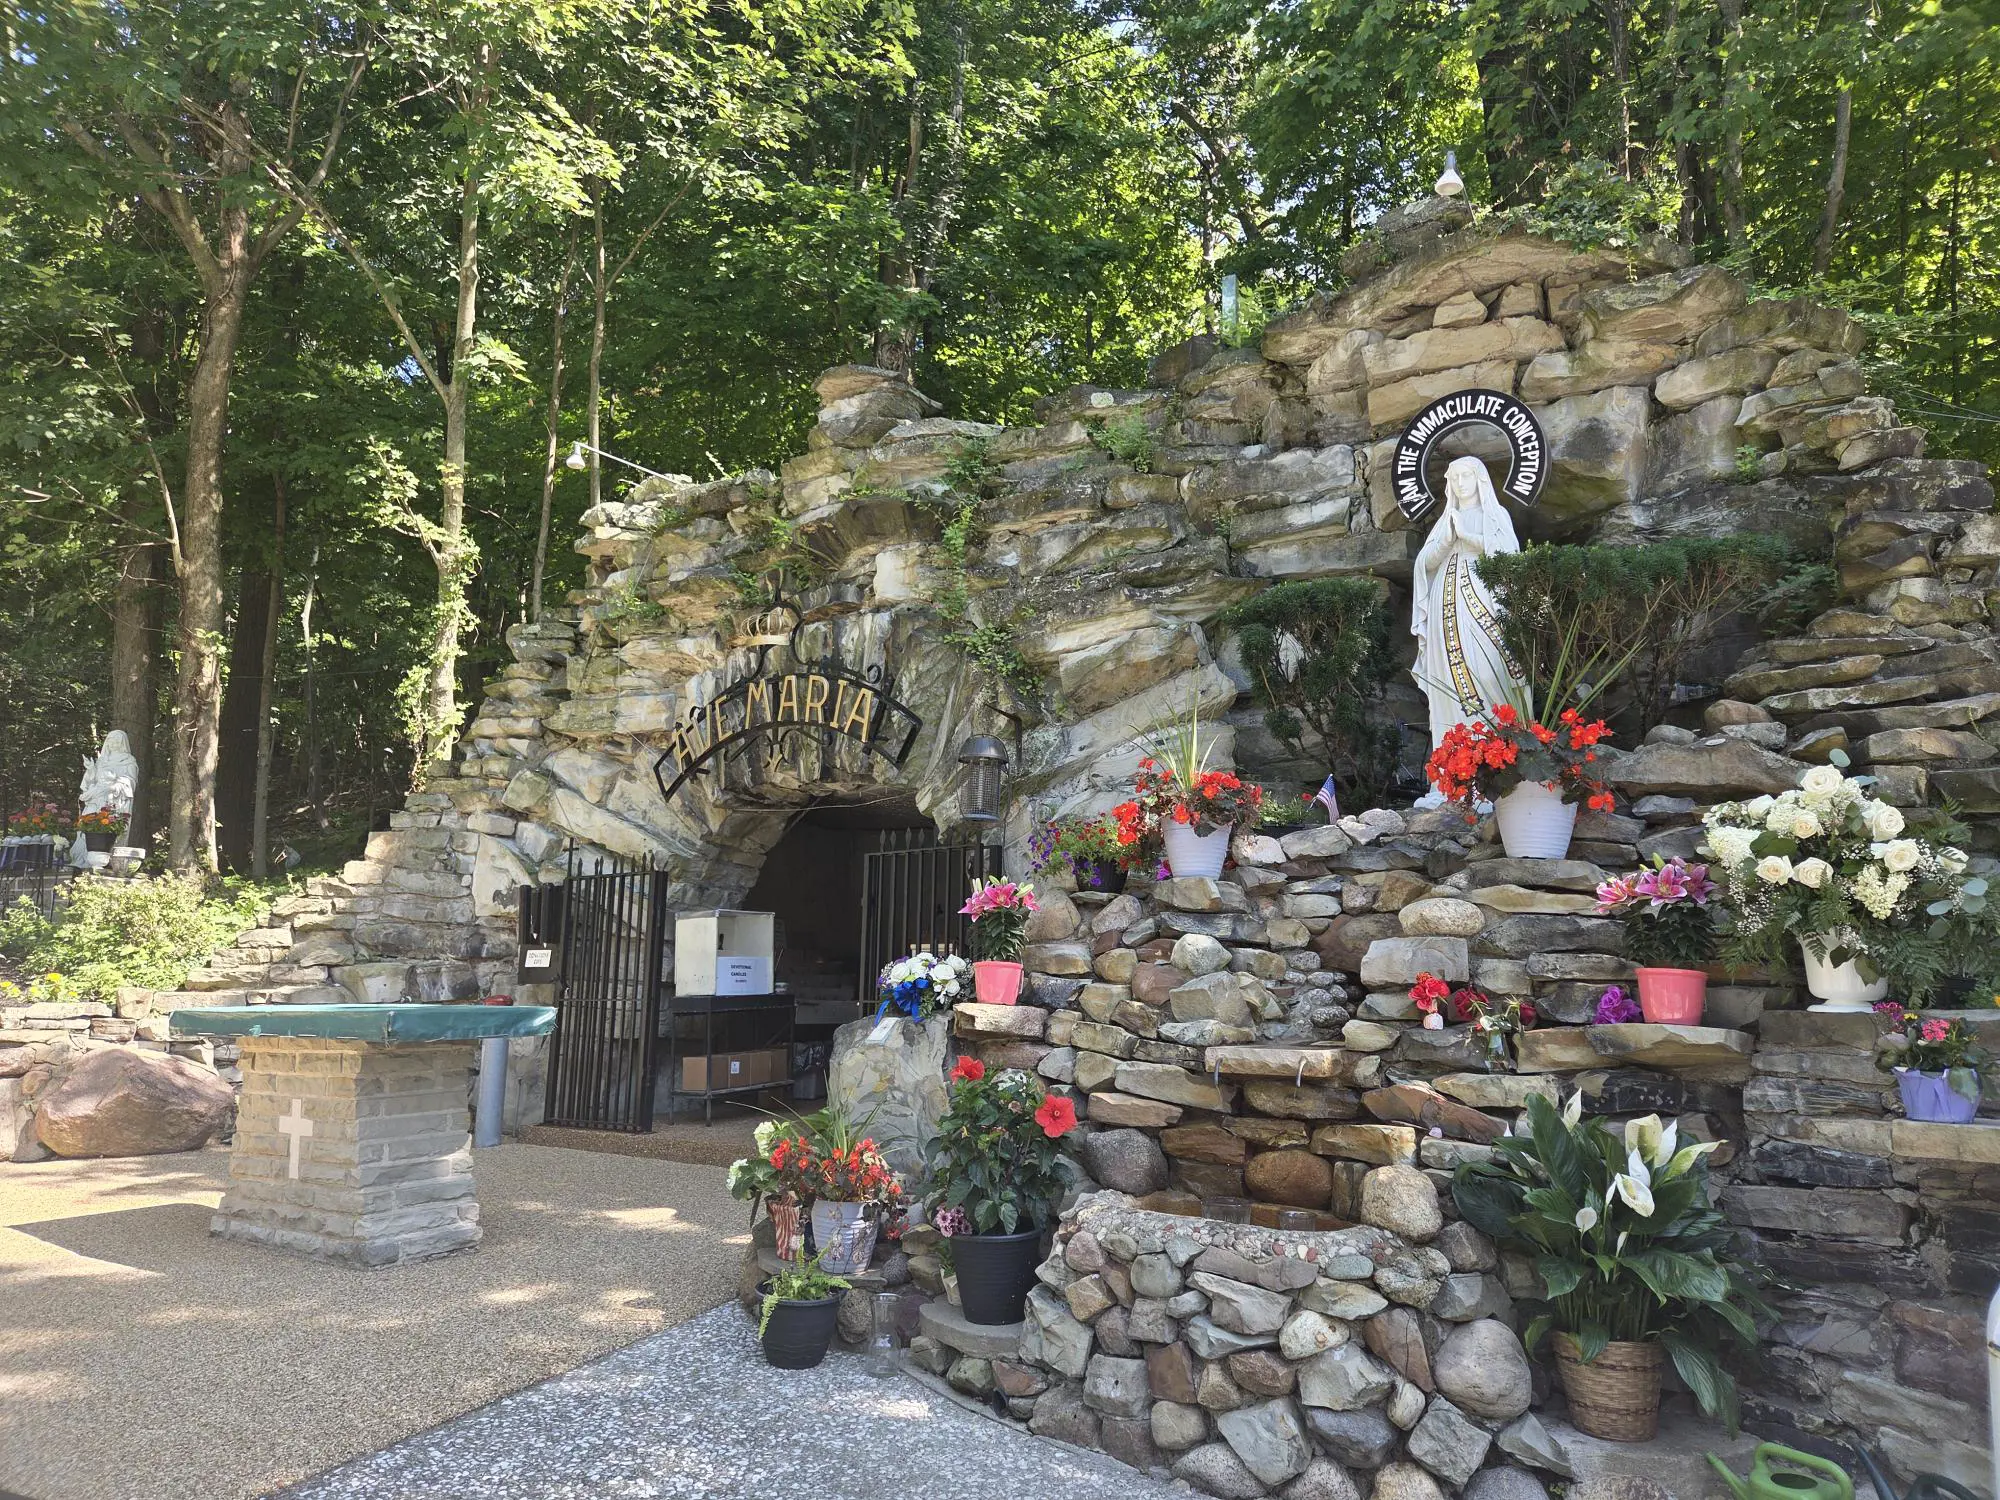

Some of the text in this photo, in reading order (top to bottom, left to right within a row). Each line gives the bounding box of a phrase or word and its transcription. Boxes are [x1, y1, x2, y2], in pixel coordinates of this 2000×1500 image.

[1408, 395, 1505, 445] IMMACULATE
[1397, 446, 1420, 475] THE
[1502, 406, 1540, 496] CONCEPTION
[1398, 477, 1422, 501] AM
[672, 674, 875, 773] AVE MARIA
